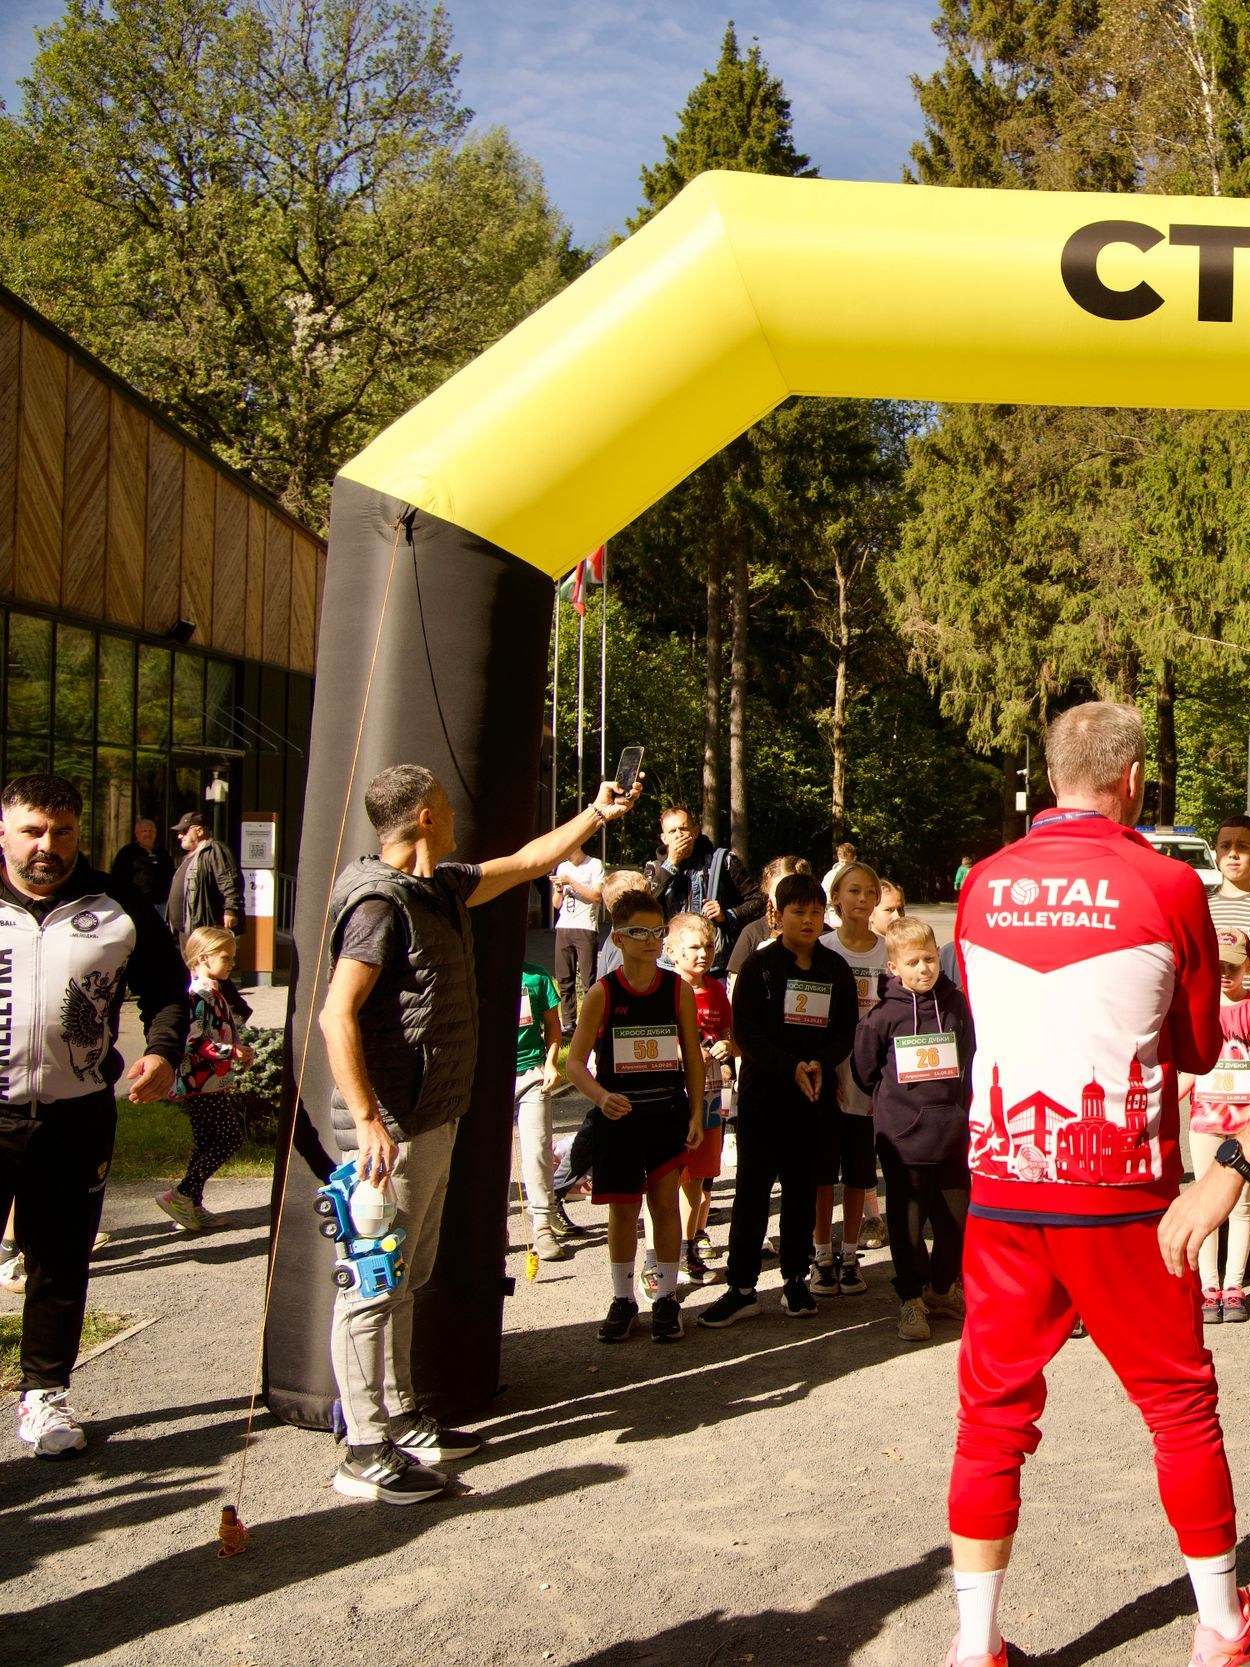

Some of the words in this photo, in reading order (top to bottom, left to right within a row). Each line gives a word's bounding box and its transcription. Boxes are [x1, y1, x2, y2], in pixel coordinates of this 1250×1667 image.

[986, 911, 1116, 930] VOLLEYBALL
[795, 993, 808, 1013] 2
[646, 1028, 671, 1036] ДУБКИ
[902, 1038, 926, 1046] КРОСС
[928, 1036, 949, 1044] ДУБКИ
[633, 1040, 658, 1060] 58
[916, 1047, 940, 1069] 26
